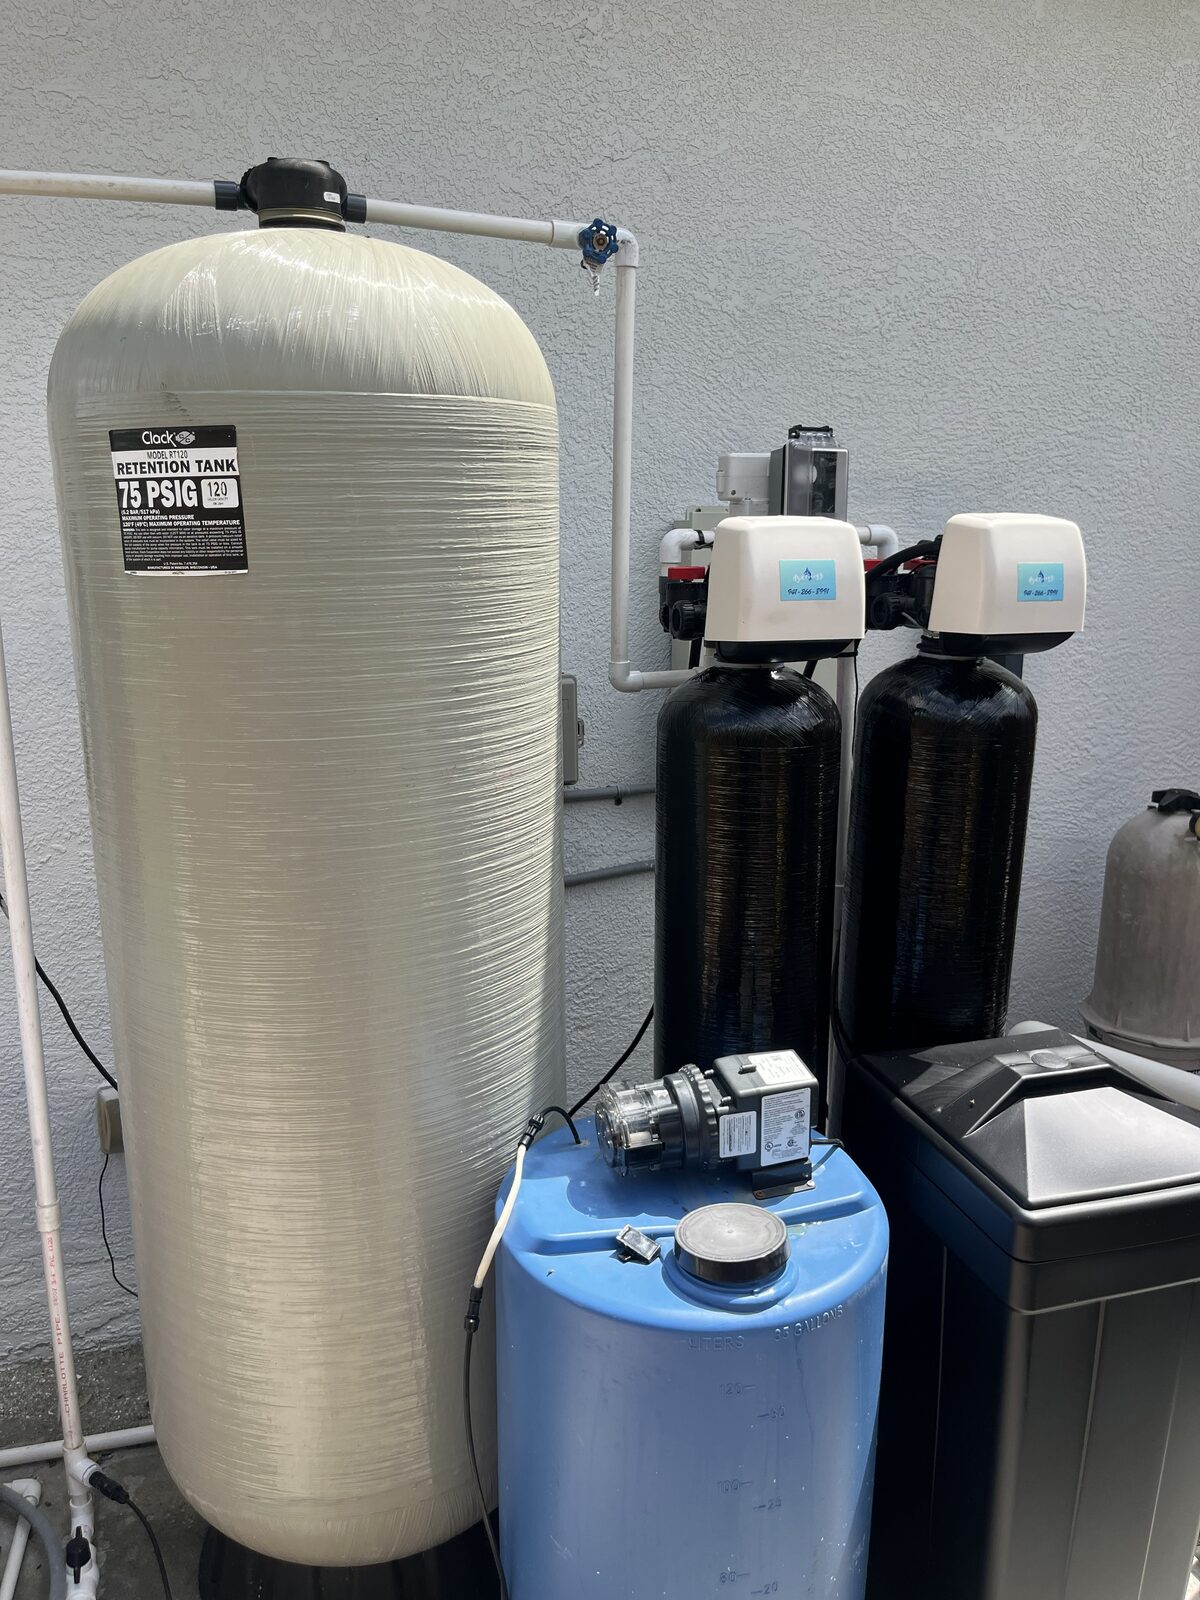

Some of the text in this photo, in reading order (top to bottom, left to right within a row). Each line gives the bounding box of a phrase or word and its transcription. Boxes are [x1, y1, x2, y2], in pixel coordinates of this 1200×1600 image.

[142, 430, 177, 447] Clack
[147, 450, 188, 460] MODEL RT120
[117, 459, 237, 475] RETENTION TANK
[118, 479, 198, 508] 75 PSIG
[207, 481, 228, 497] 120
[774, 1304, 843, 1341] 35 GALLONS
[688, 1335, 745, 1351] LITERS
[58, 1352, 70, 1413] CHARLOTTE
[720, 1382, 743, 1396] 120
[763, 1581, 779, 1595] 20
